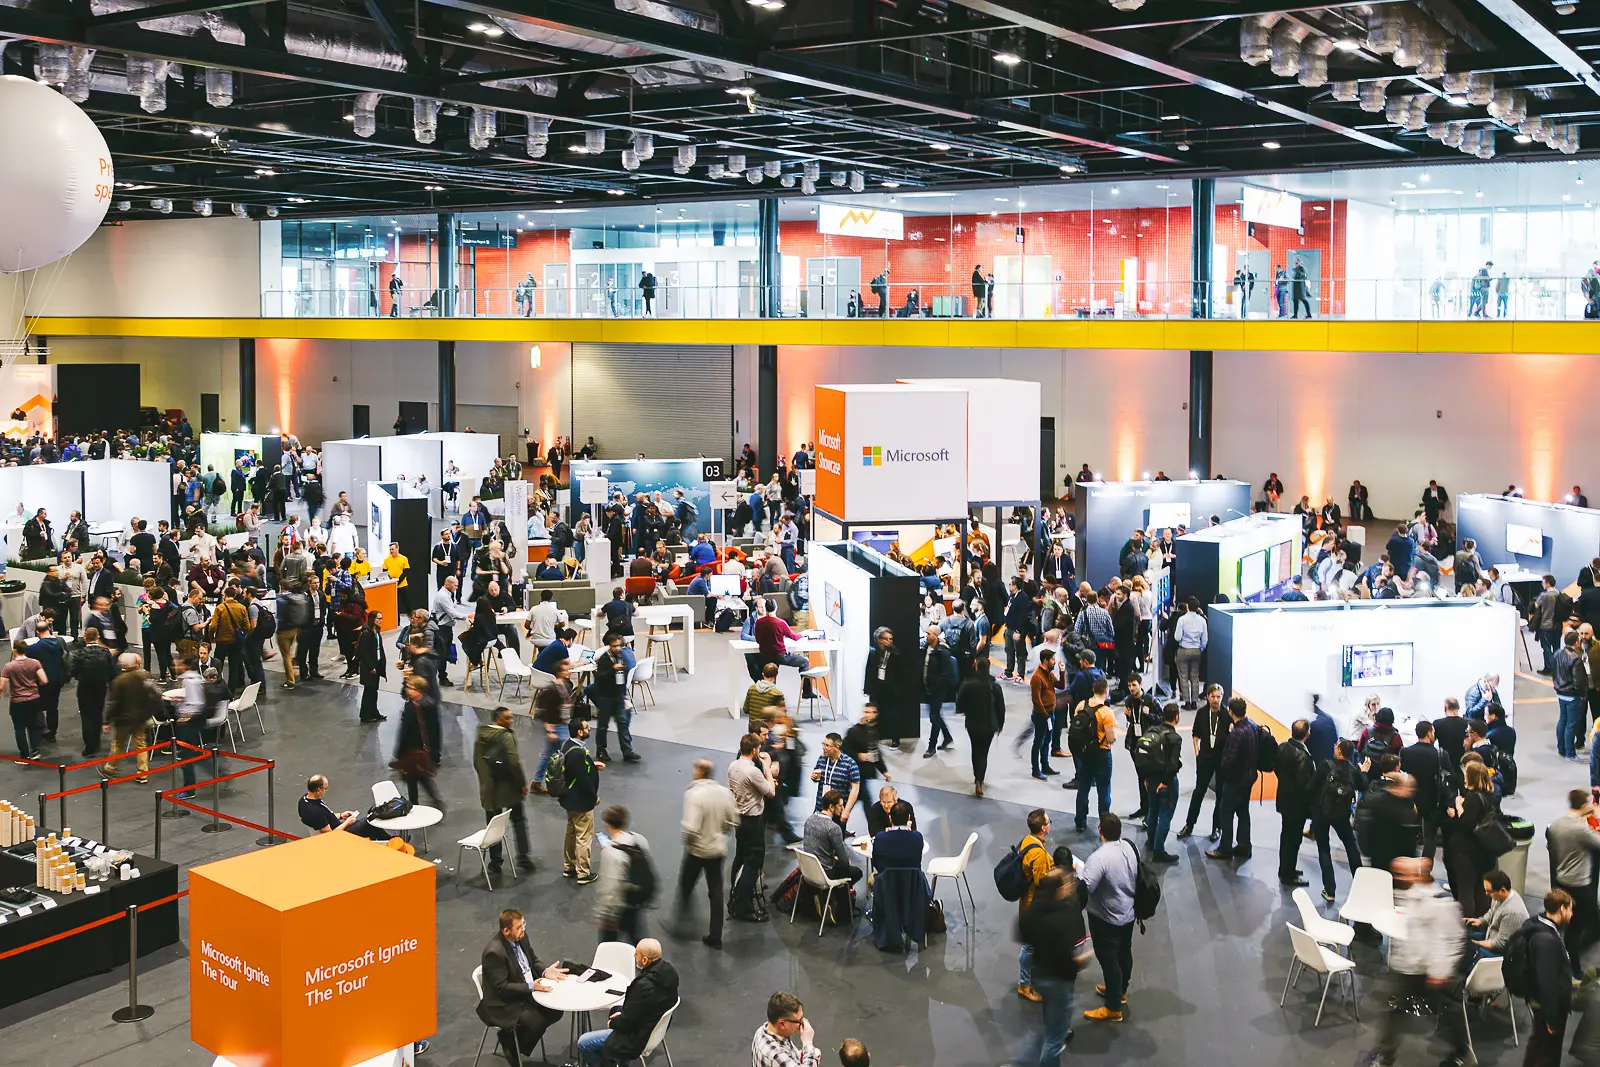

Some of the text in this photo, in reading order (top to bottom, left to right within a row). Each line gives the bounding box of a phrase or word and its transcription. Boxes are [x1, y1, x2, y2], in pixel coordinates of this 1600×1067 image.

[99, 157, 114, 177] Pr
[826, 268, 837, 285] 5
[818, 429, 841, 451] Microsoft
[818, 452, 841, 476] Showcase
[886, 448, 950, 462] Microsoft
[705, 465, 721, 477] 03
[201, 940, 270, 987] Microsoft Ignite
[305, 938, 418, 986] Microsoft Ignite
[201, 960, 238, 991] The Tour
[304, 975, 369, 1007] The Tour
